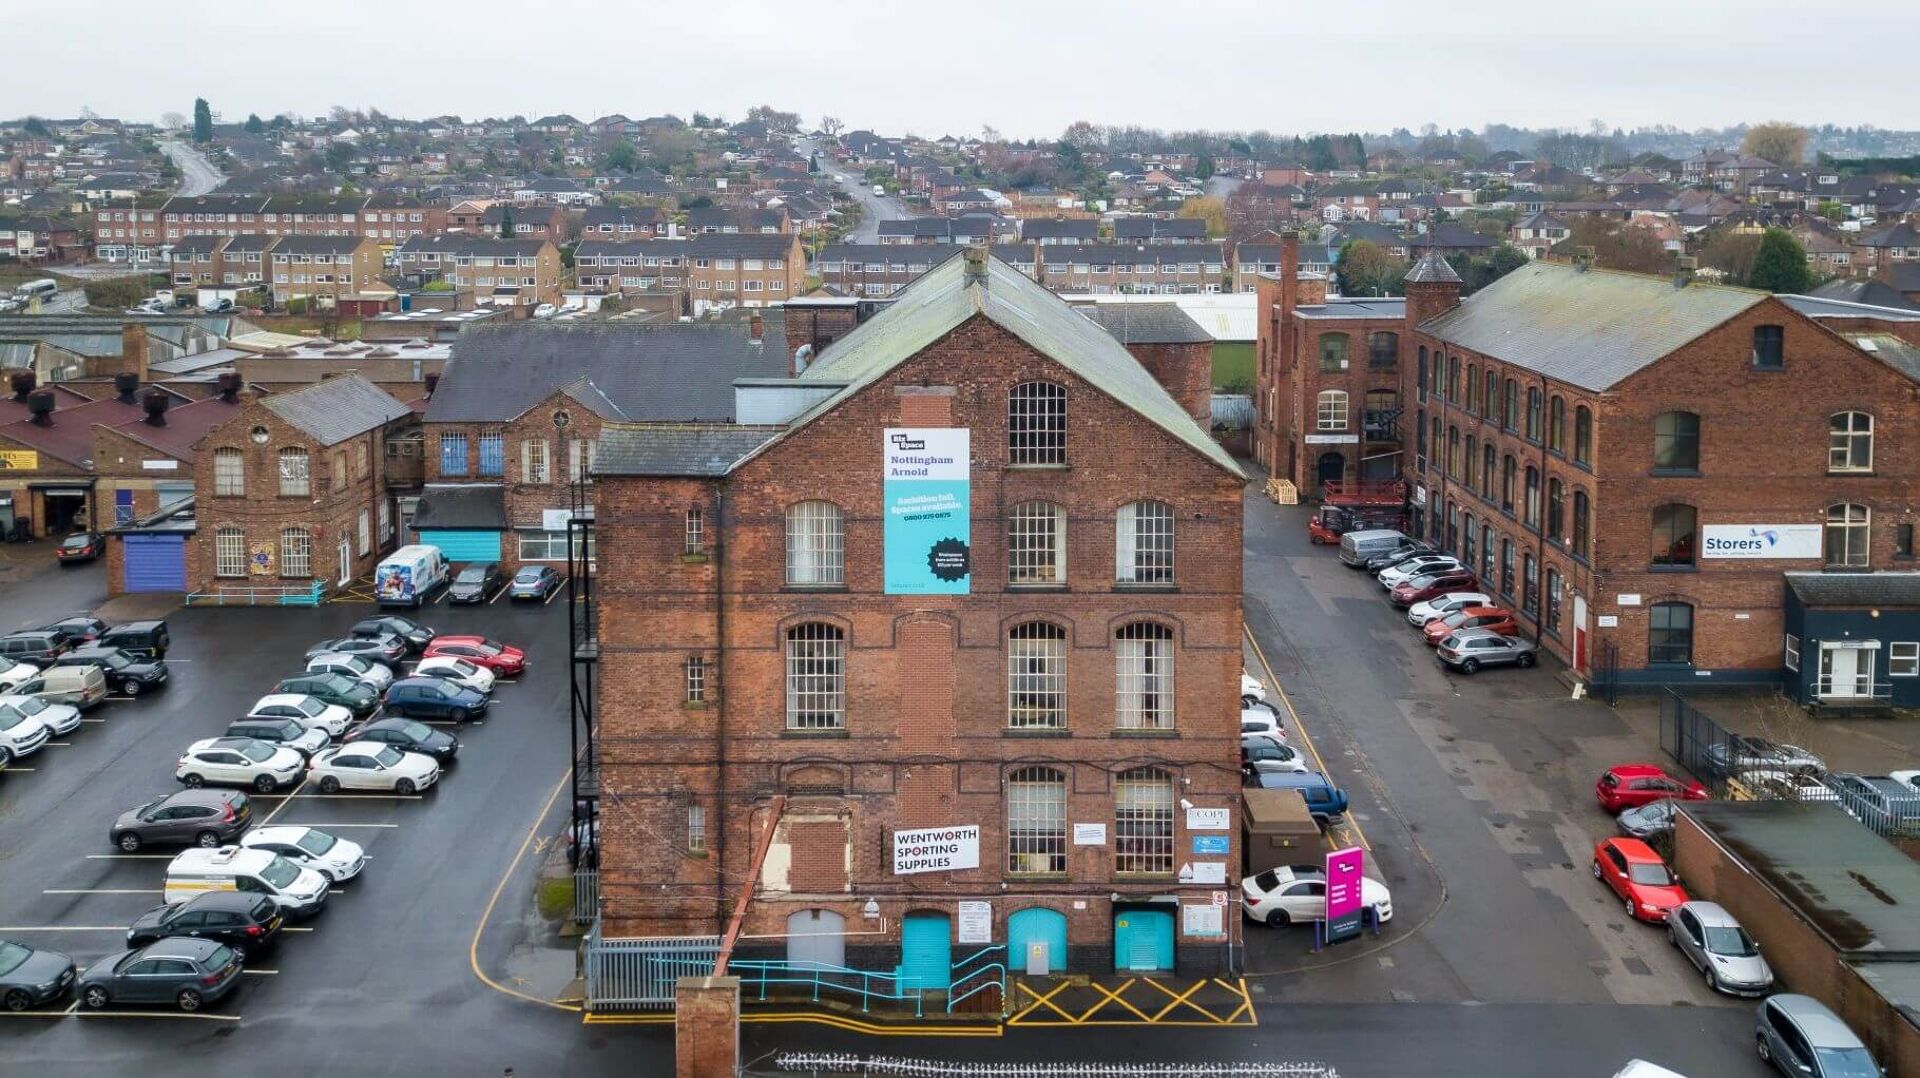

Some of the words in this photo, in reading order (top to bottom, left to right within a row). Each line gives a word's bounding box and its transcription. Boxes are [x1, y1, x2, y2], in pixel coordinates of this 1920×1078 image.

[891, 456, 954, 465] Nottingham
[891, 467, 928, 476] Arnold
[1706, 538, 1762, 549] Storers
[897, 829, 977, 844] WENTWORTH
[897, 844, 958, 857] SPORTING
[897, 857, 951, 870] SUPPLIES
